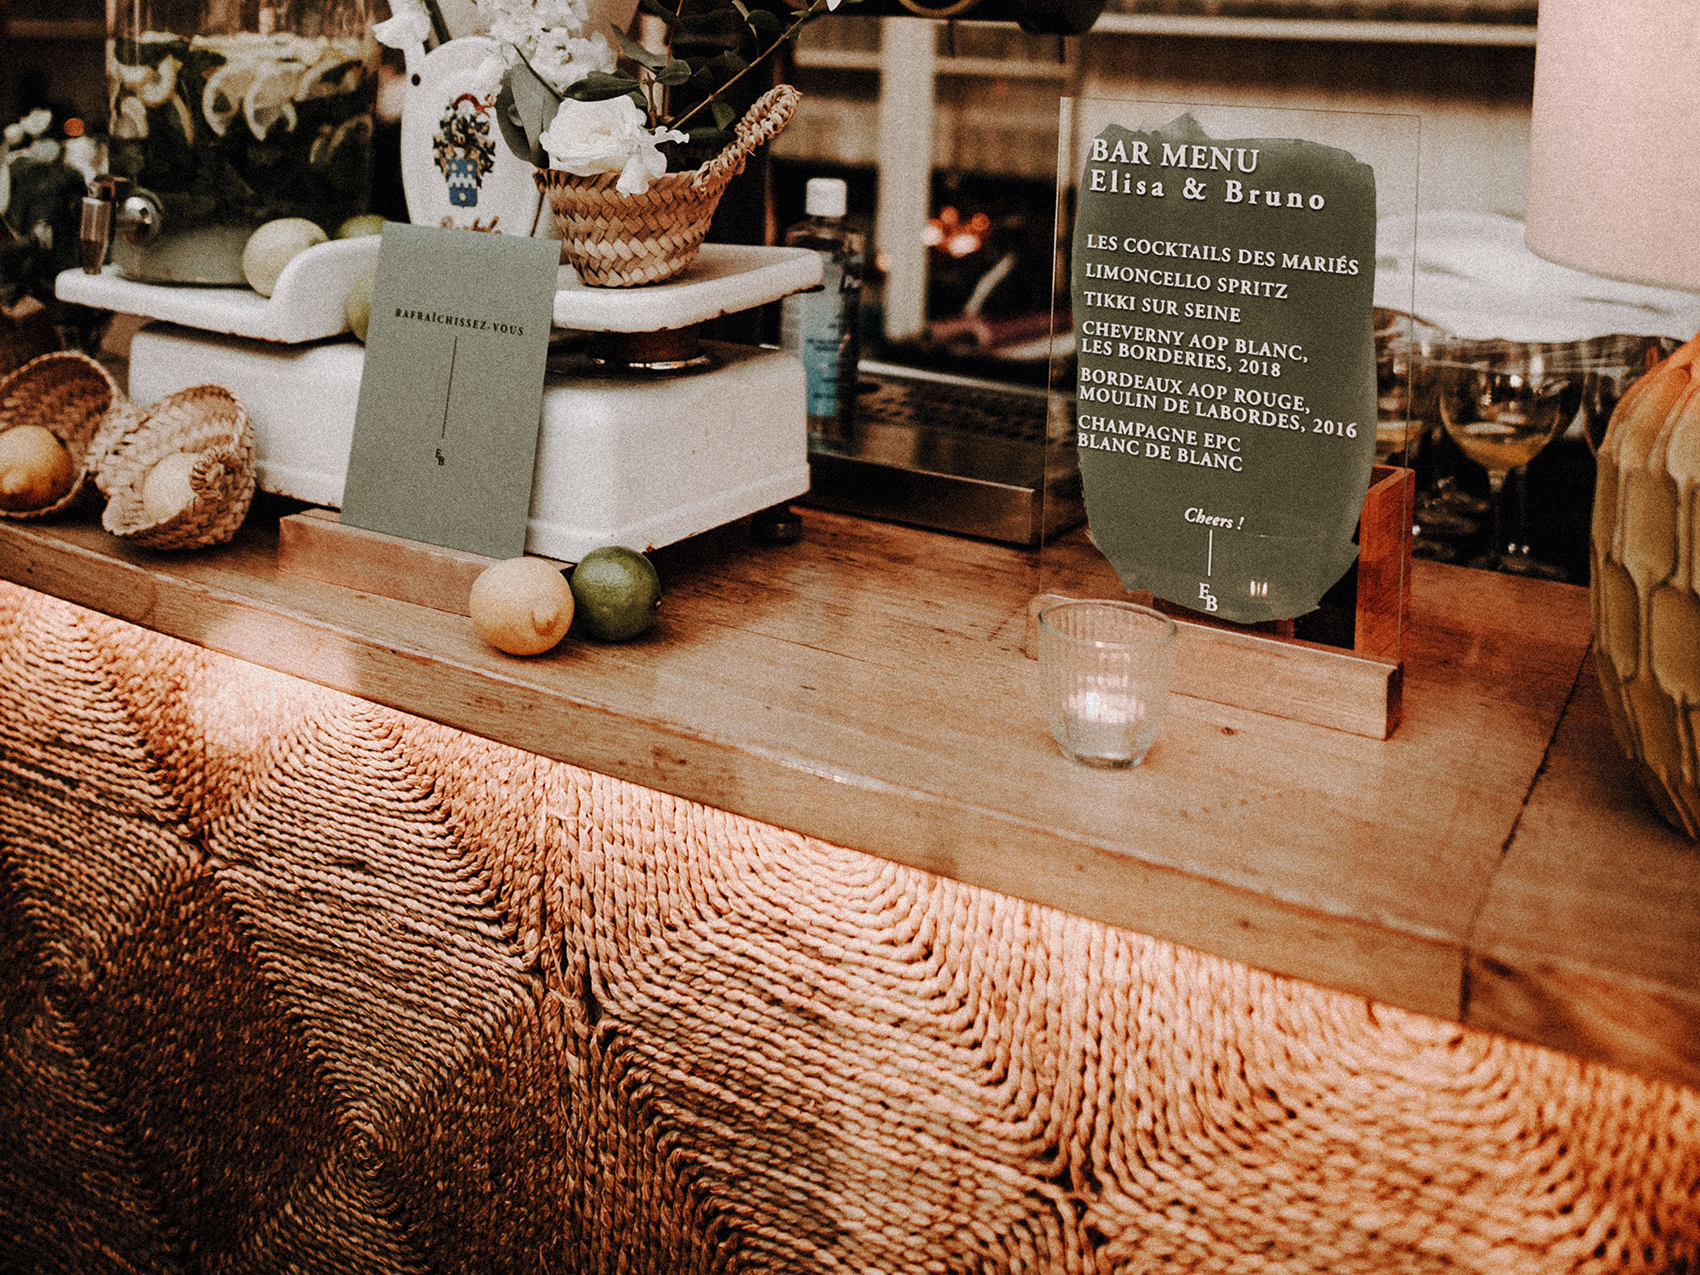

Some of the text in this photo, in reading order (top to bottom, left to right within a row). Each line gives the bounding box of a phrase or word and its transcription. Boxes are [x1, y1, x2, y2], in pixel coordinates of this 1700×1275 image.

[1090, 138, 1260, 173] BAR MENU
[1089, 169, 1326, 210] Elisa & Bruno
[1086, 234, 1360, 275] LES COCKTAILS DES MARIÉS
[1085, 263, 1288, 300] LIMONCELLO SPRITZ
[1083, 291, 1241, 323] TIKKI SUR SEINE
[1081, 320, 1308, 363] CHEVERNY AOP BLANC,
[1081, 338, 1281, 377] LES BORDERIES, 2018
[1080, 367, 1310, 414] BORDEAUX AOP ROUGE,
[1079, 386, 1358, 439] MOULIN DE LABORDES, 2016
[1077, 433, 1243, 472] BLANC DE BLANC
[1078, 414, 1241, 452] CHAMPAGNE EPC
[1184, 507, 1234, 530] Cheers
